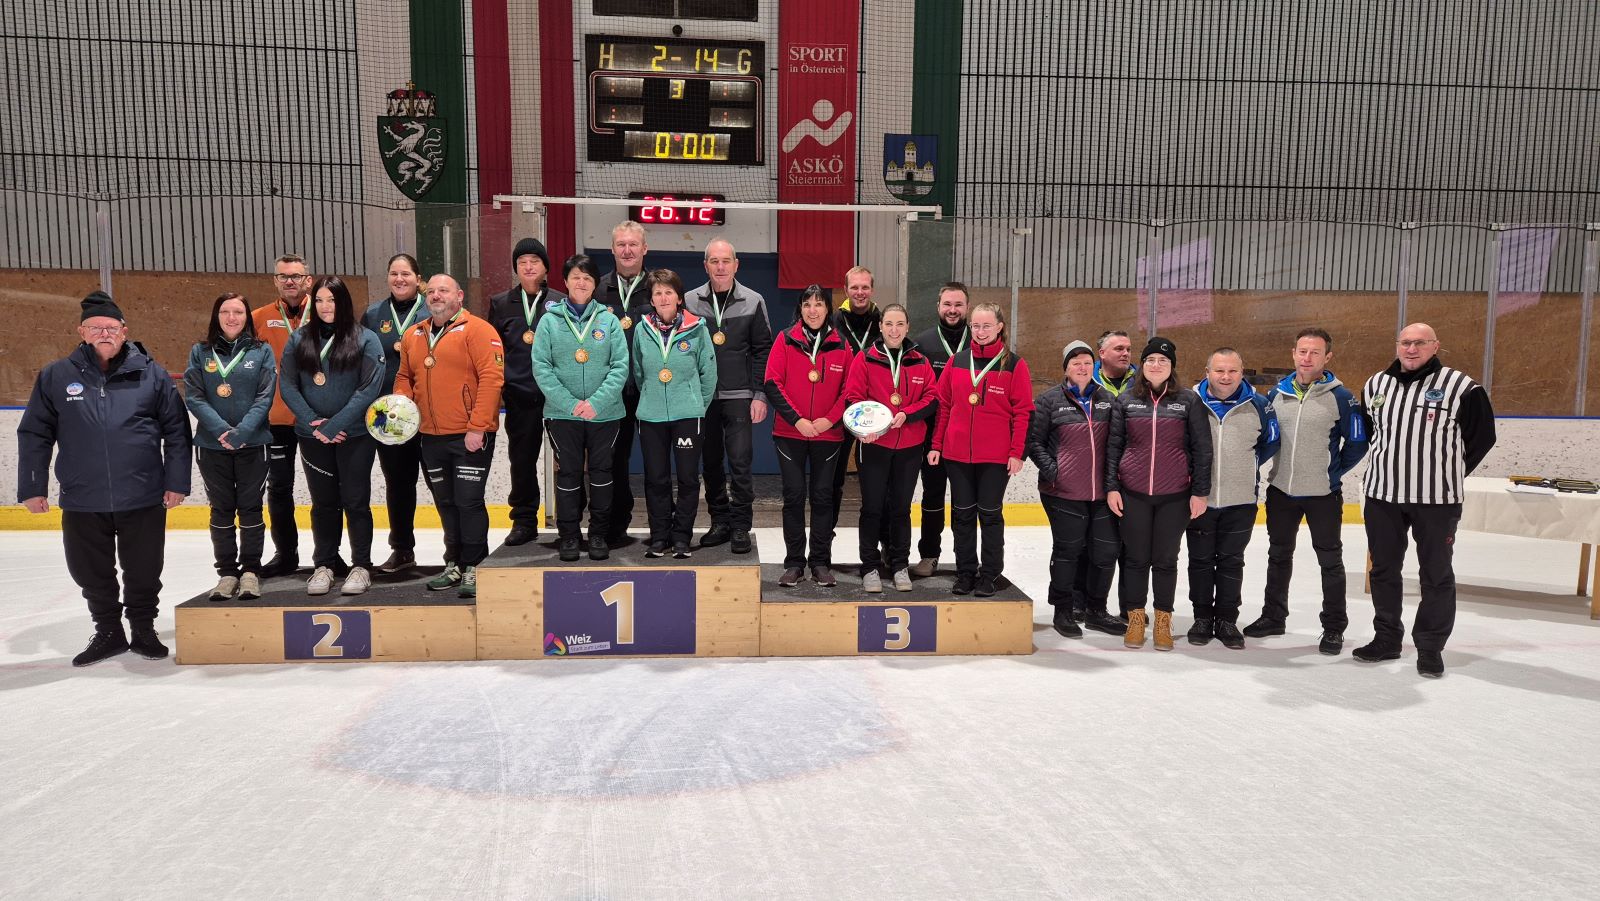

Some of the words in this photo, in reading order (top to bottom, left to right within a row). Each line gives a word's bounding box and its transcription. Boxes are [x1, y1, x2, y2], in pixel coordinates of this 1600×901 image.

[599, 43, 614, 69] H
[737, 49, 752, 74] G
[789, 46, 847, 61] SPORT
[789, 64, 798, 73] in
[800, 62, 846, 74] Österreich
[671, 80, 682, 99] 3
[788, 154, 844, 174] ASKÖ
[788, 173, 842, 185] Steiermark
[600, 581, 634, 644] 1
[311, 613, 344, 657] 2
[883, 607, 911, 650] 3
[565, 633, 591, 645] Weiz
